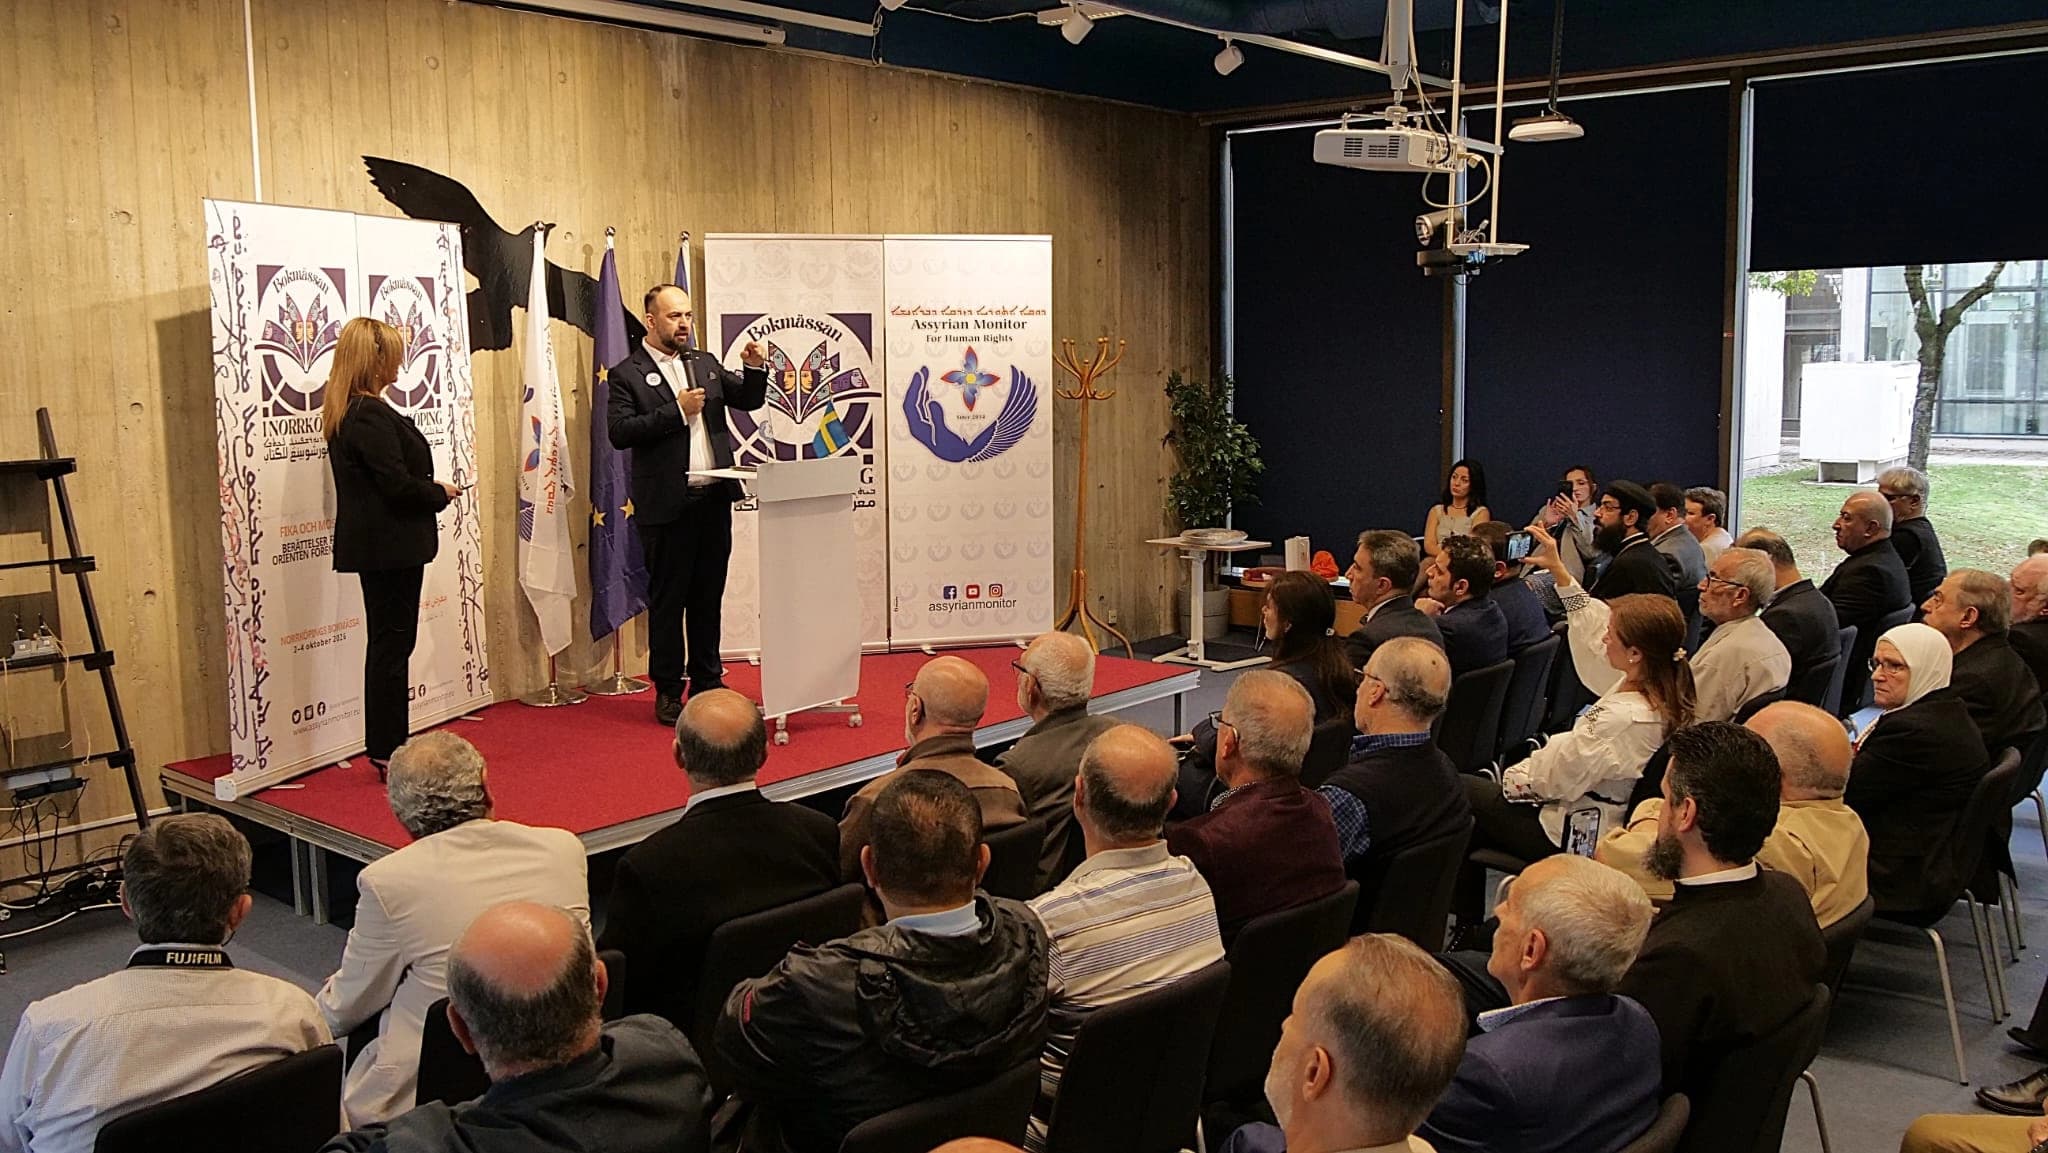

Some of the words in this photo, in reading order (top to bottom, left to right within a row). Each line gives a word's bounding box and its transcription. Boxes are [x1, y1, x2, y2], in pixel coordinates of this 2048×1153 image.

[273, 267, 329, 295] Bokmässan
[746, 314, 843, 342] Bokmässan
[911, 319, 969, 333] Assyrian
[973, 319, 1028, 330] Monitor
[926, 335, 942, 343] For
[945, 335, 980, 343] Human
[983, 334, 1013, 344] Rights
[269, 413, 323, 437] NORRKÖ
[413, 410, 443, 426] ÖPING
[852, 499, 876, 511] معر
[280, 525, 298, 538] FIKA
[300, 521, 317, 534] OCH
[272, 550, 310, 565] ORIENTEN
[928, 599, 1017, 613] assyrianmonitor
[306, 638, 331, 650] oktober
[166, 952, 222, 964] FUJIFILM
